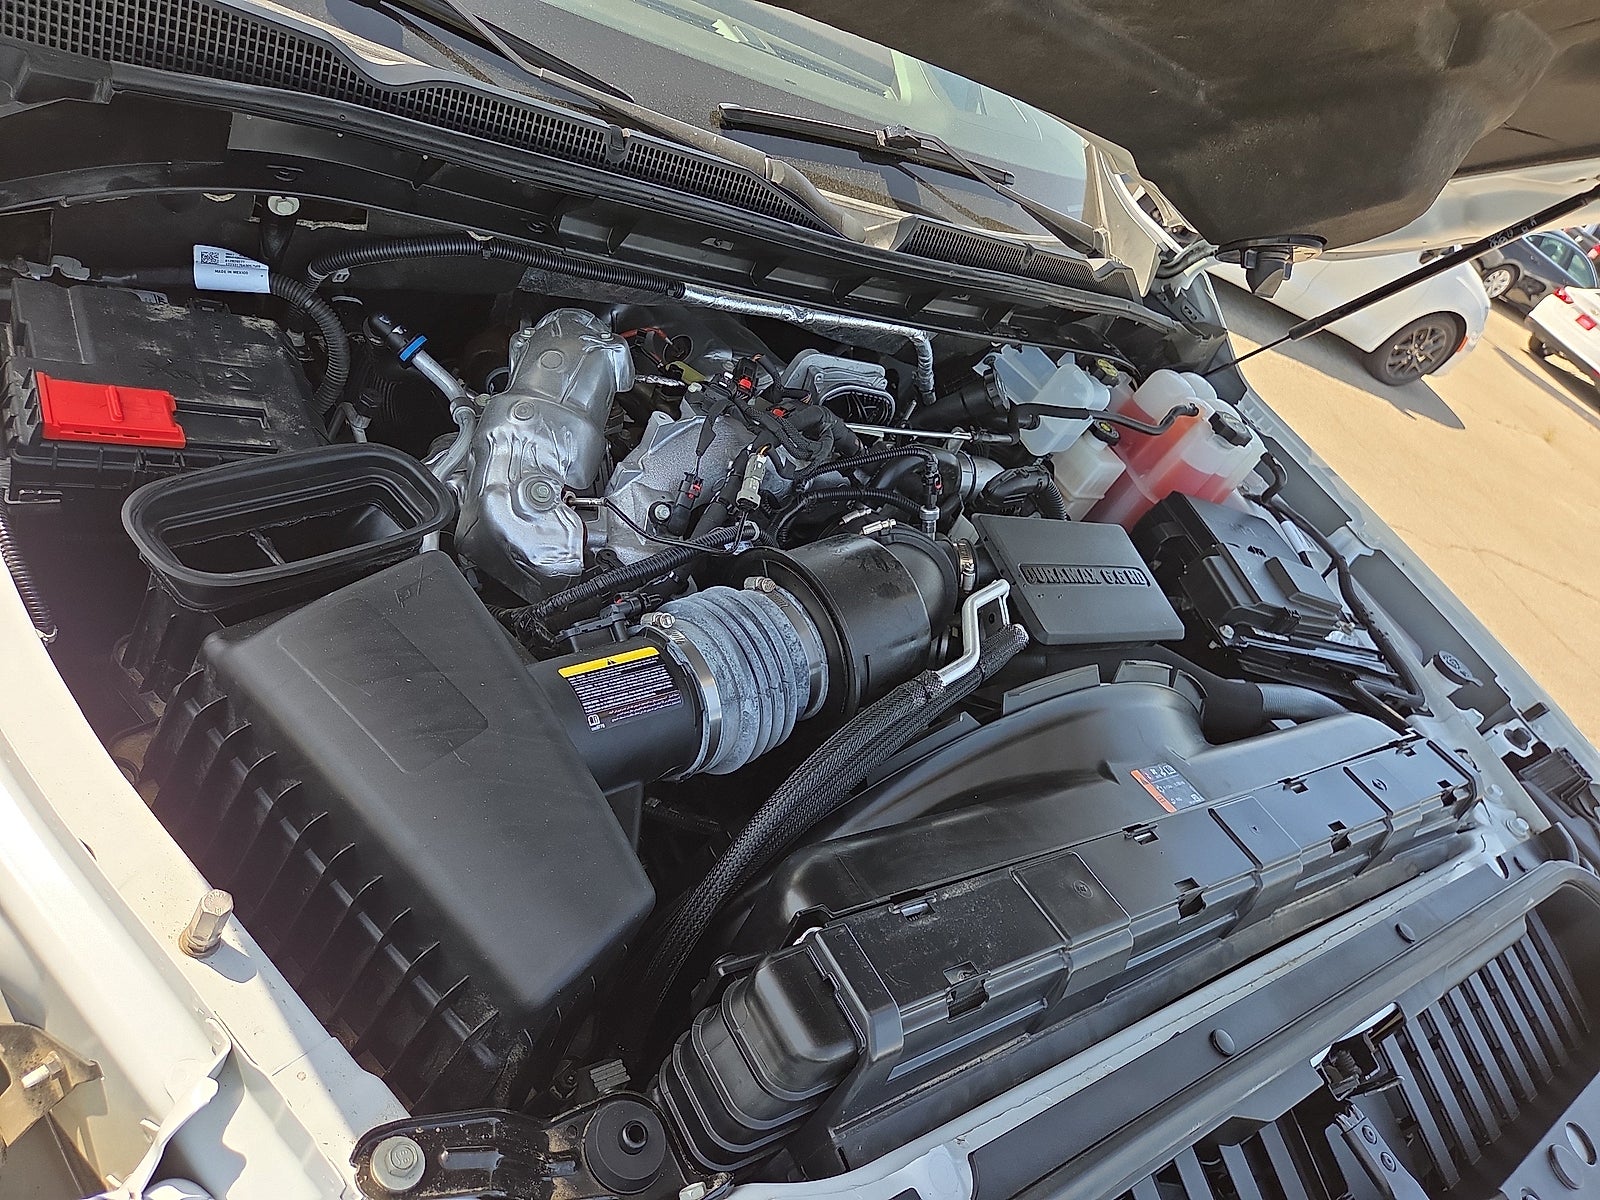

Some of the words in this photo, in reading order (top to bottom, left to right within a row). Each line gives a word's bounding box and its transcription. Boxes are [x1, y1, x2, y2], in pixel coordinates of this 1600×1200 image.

[1024, 566, 1102, 585] DURAMAX
[1101, 568, 1127, 585] 6.6
[1125, 569, 1148, 586] HD
